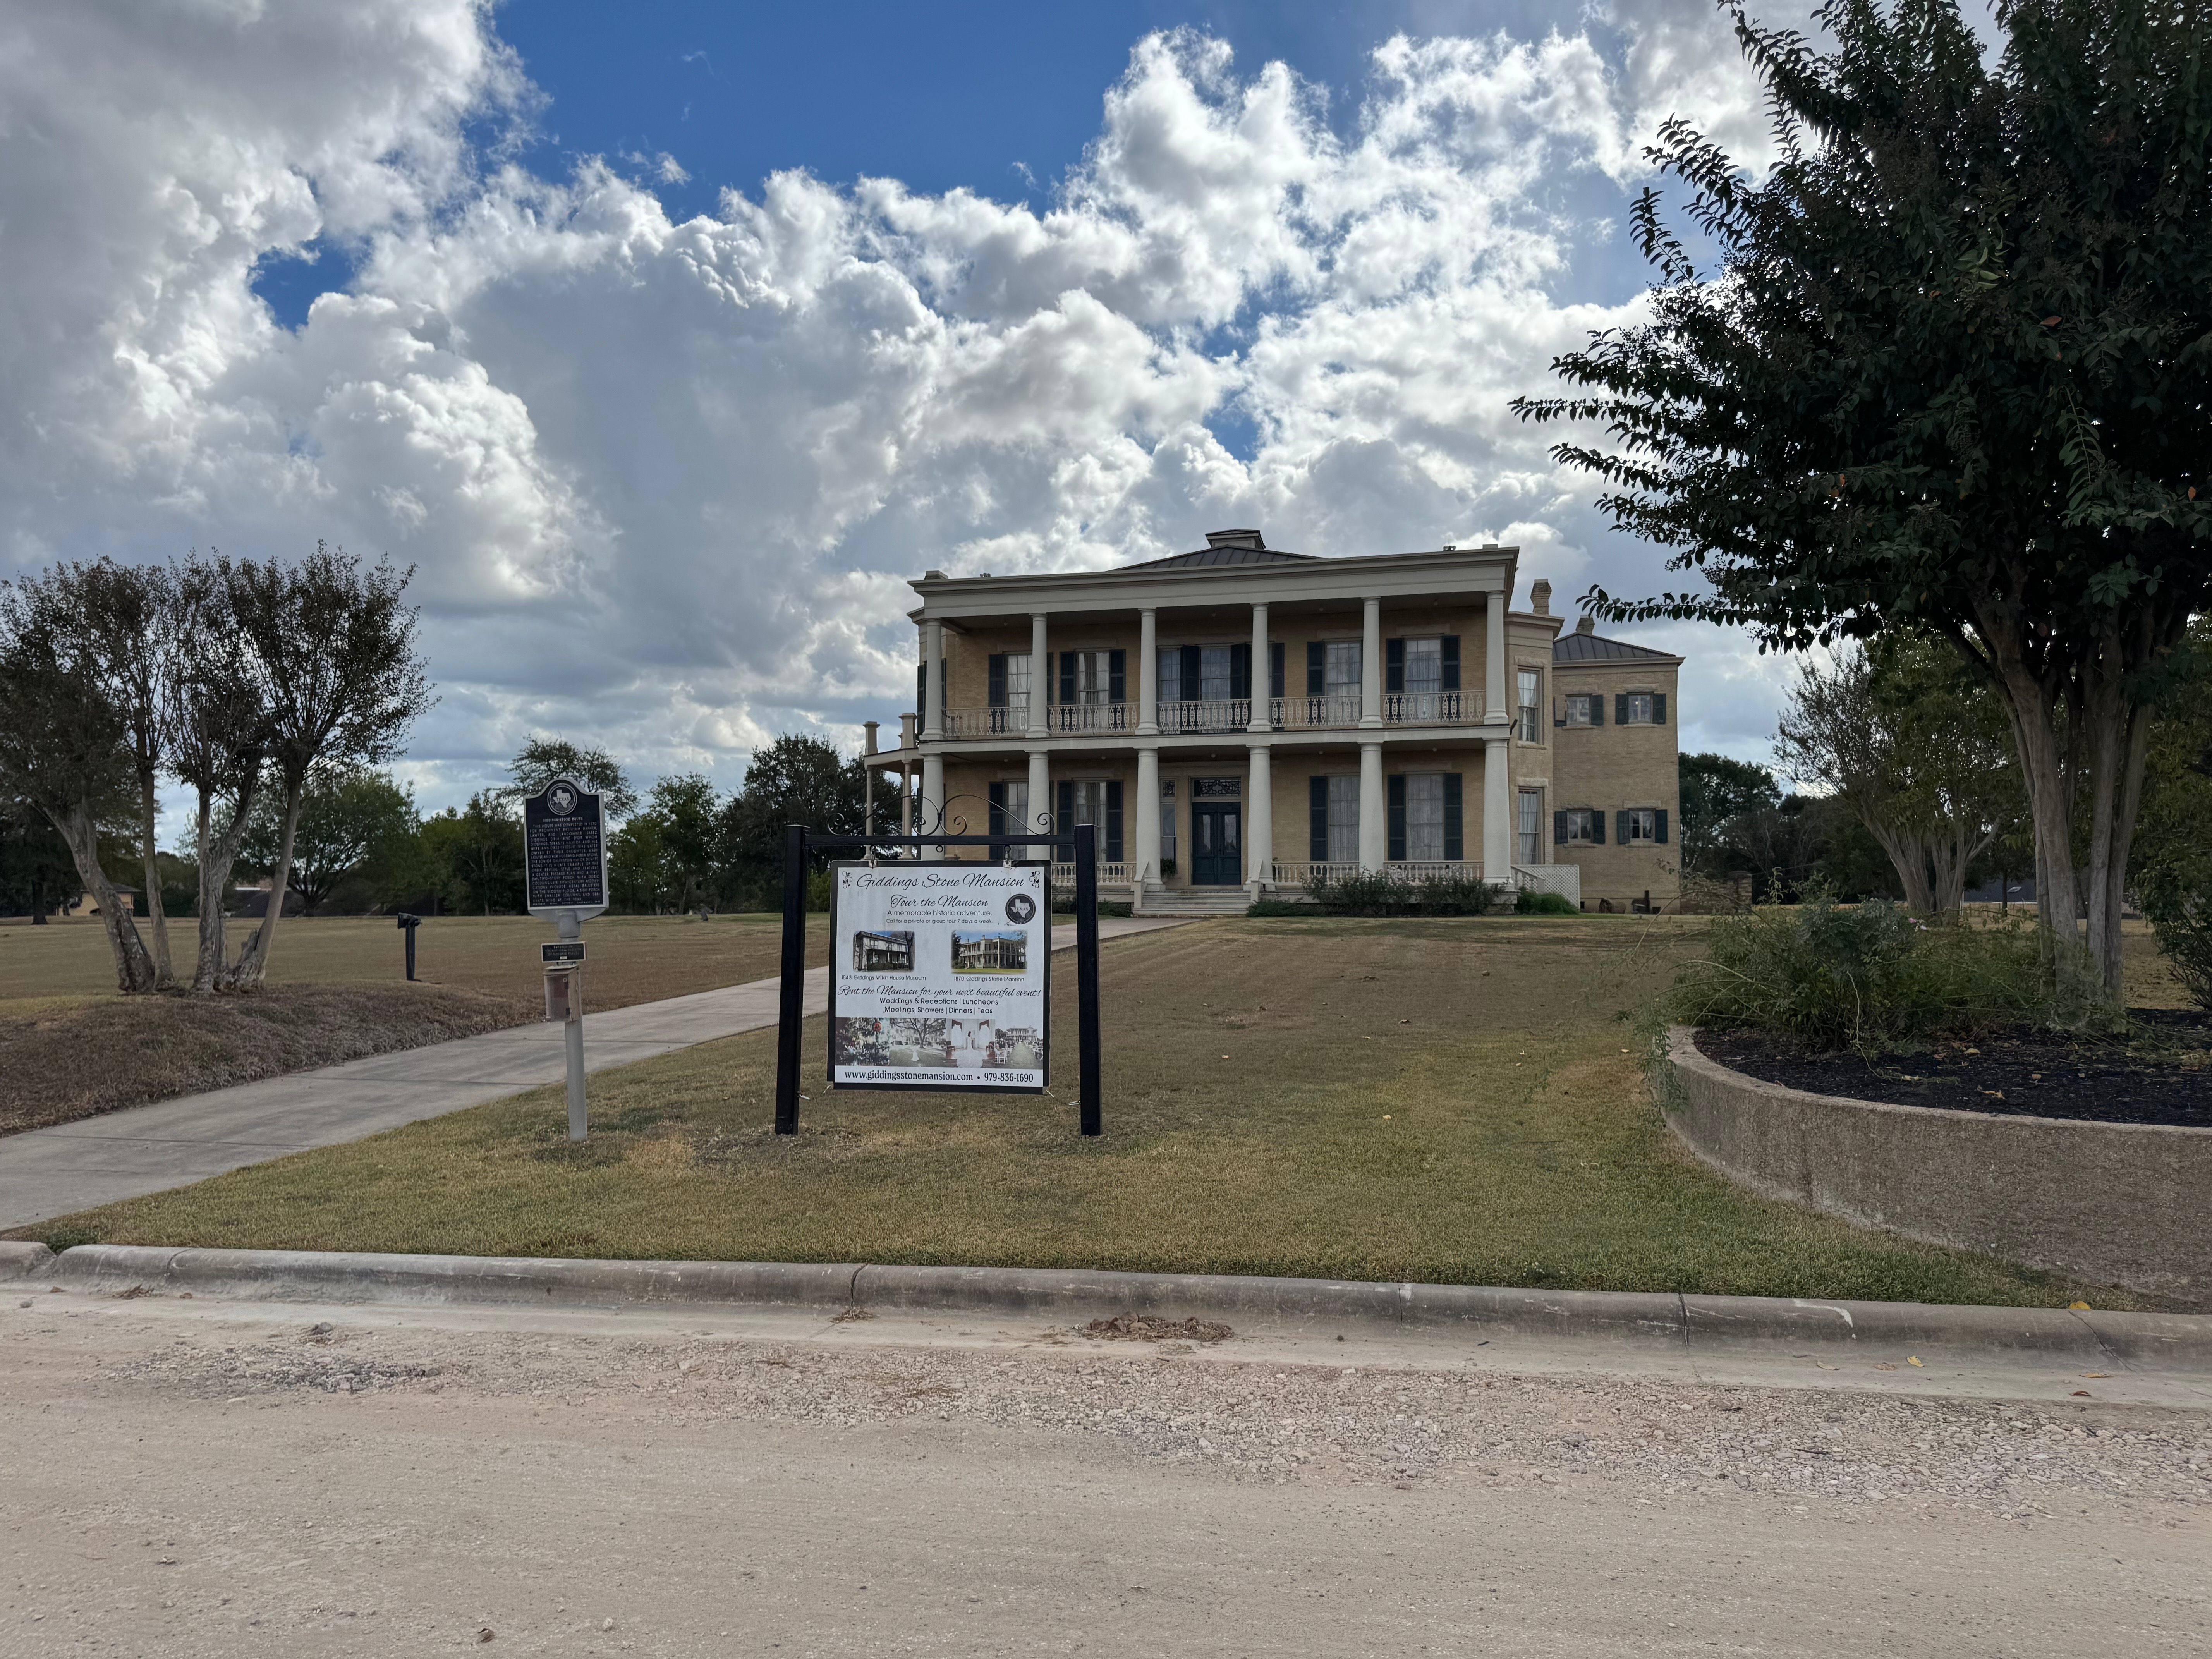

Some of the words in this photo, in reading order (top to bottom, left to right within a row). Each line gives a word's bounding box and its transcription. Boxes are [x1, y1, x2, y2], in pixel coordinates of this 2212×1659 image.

[857, 874, 919, 890] Giddings
[922, 874, 960, 888] Stone
[963, 873, 1024, 888] Mansion
[891, 894, 918, 908] Tour
[920, 897, 936, 907] the
[938, 895, 988, 907] Mansion
[838, 985, 860, 996] Rent
[862, 987, 875, 995] the
[876, 985, 919, 996] Mansion
[917, 987, 932, 998] for
[934, 988, 954, 998] your
[956, 988, 975, 996] next
[976, 988, 1015, 998] beautiful
[845, 1070, 973, 1081] www.giddingsstonemansion.com
[984, 1072, 1034, 1082] 979-836-1690
